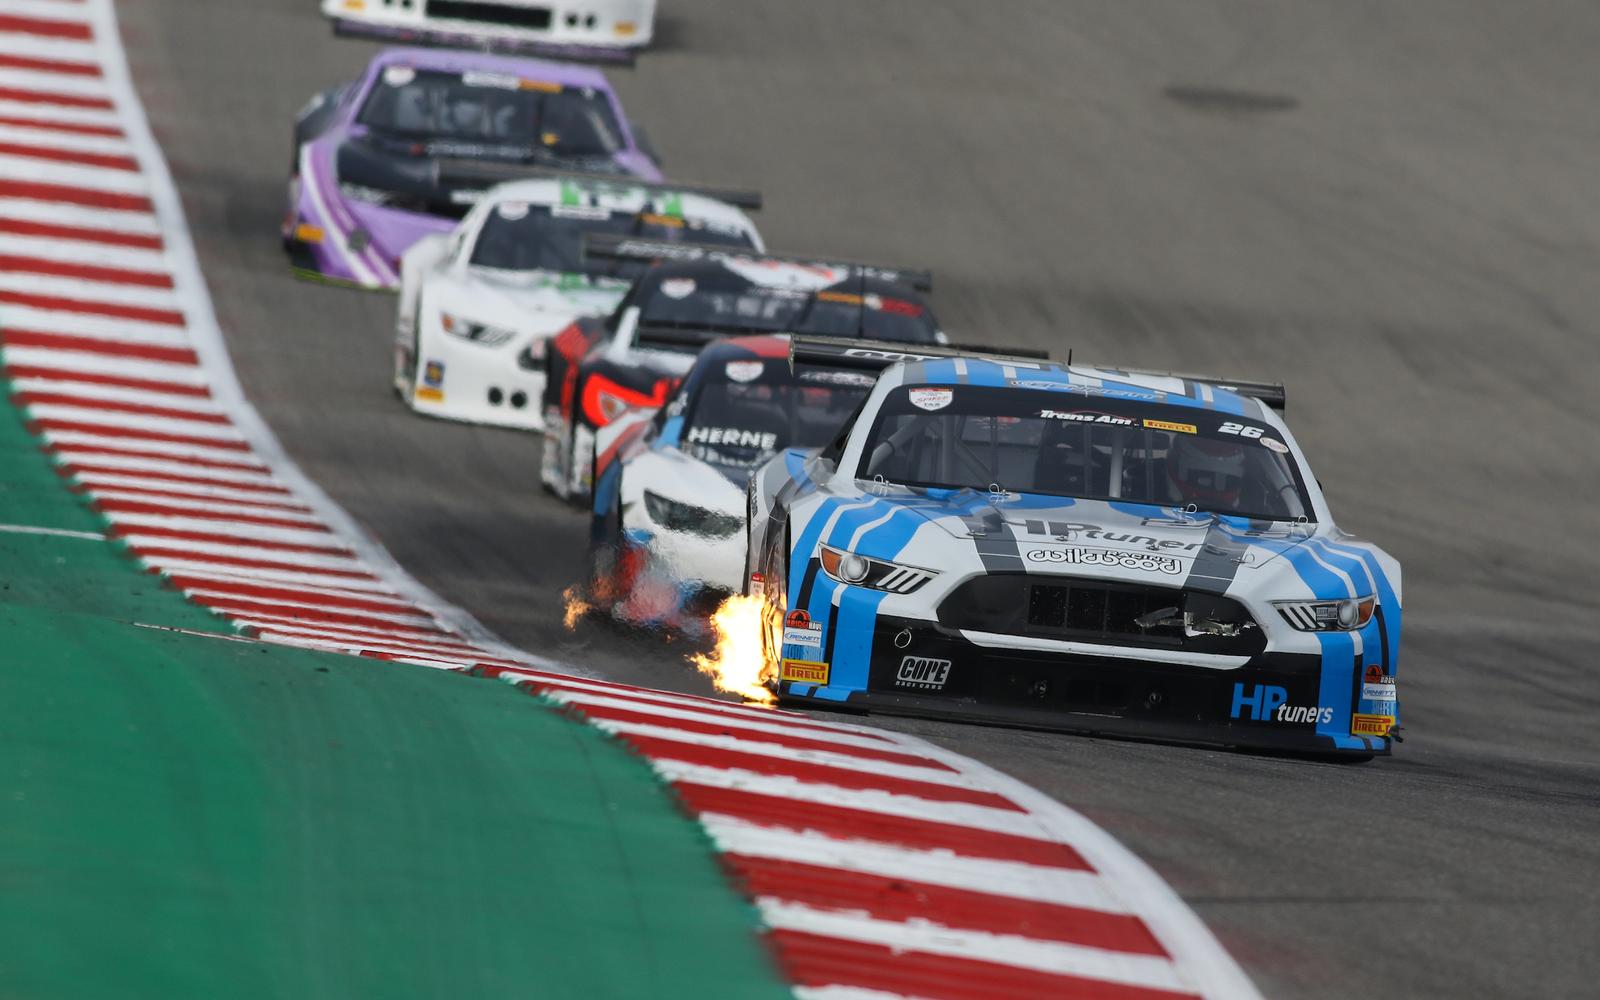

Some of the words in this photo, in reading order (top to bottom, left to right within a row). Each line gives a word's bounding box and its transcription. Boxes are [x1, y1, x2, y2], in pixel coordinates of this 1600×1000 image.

[1040, 409, 1094, 422] Trans
[1094, 414, 1132, 426] Am
[688, 426, 777, 450] HERNE
[1218, 421, 1265, 439] 26
[1026, 548, 1182, 575] wilwood
[784, 661, 826, 680] PIRELLI
[900, 658, 949, 683] COPE
